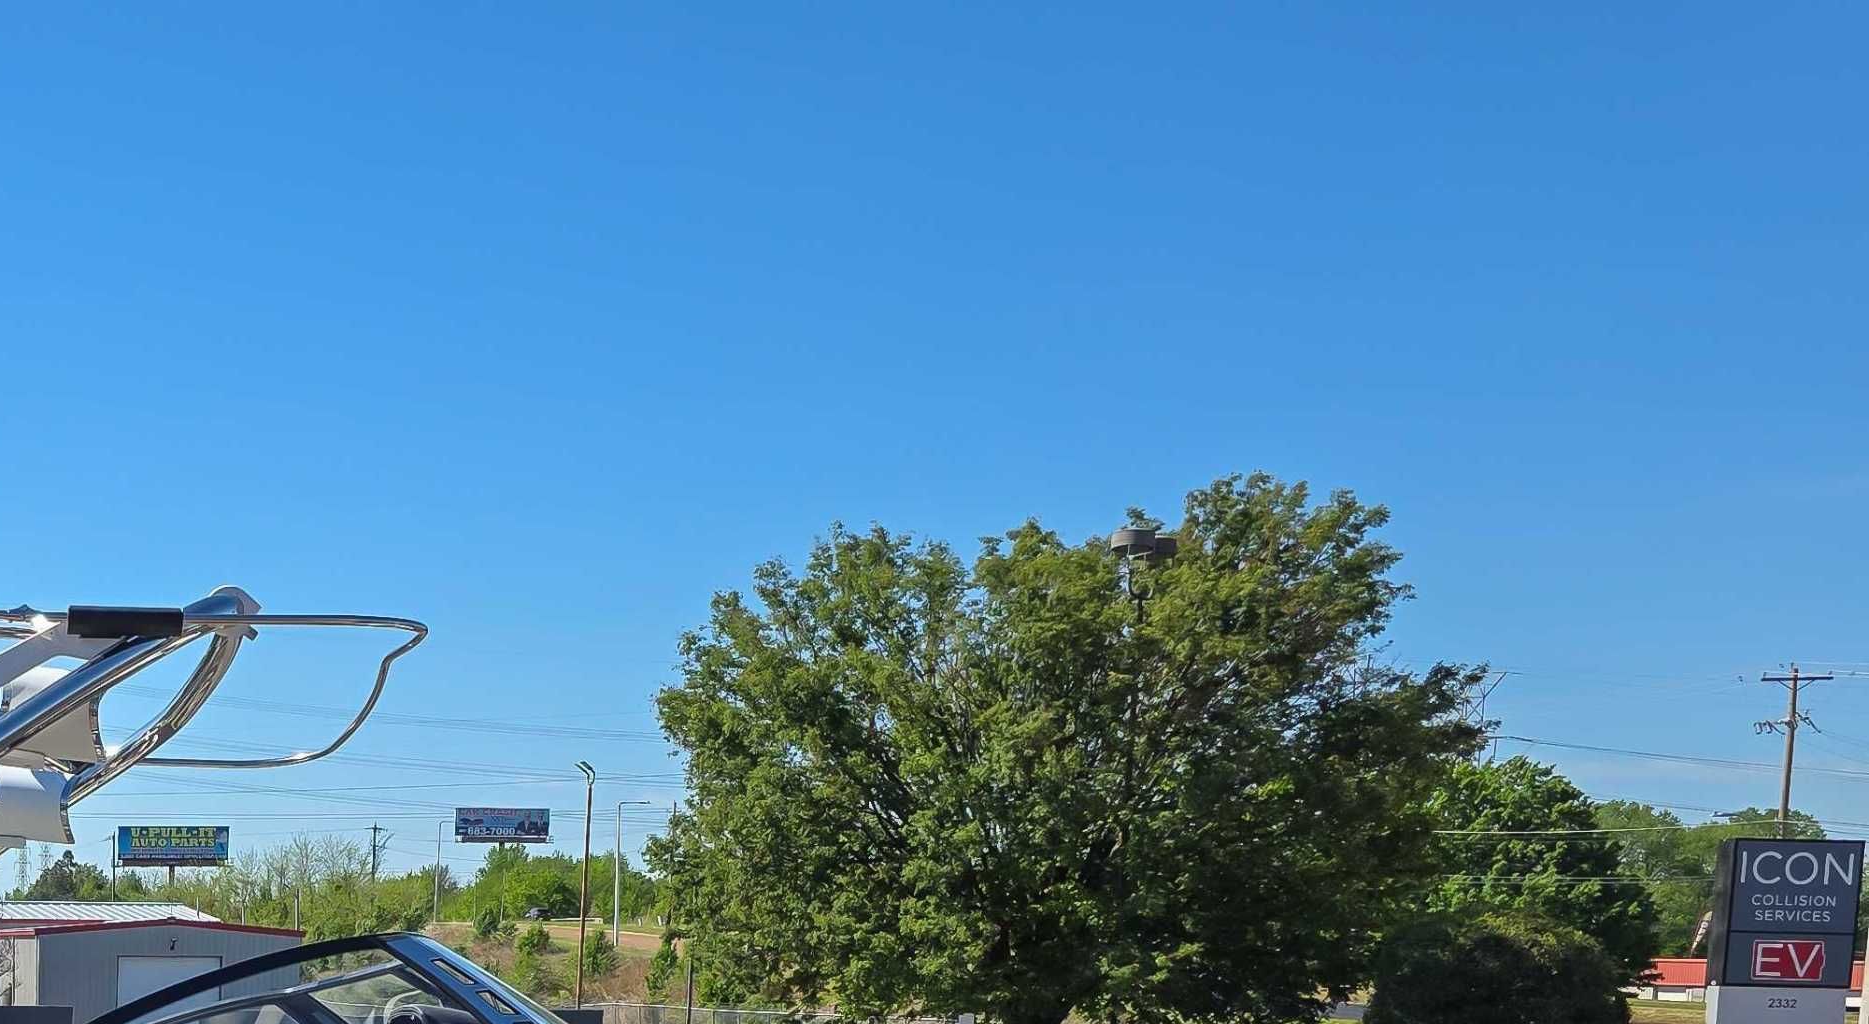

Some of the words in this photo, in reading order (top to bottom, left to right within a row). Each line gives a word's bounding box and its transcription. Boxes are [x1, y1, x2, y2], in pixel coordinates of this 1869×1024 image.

[131, 838, 168, 848] AUTO
[170, 838, 215, 847] PARTS
[1739, 850, 1855, 886] ICON
[1751, 893, 1837, 908] COLLISION
[1754, 909, 1832, 922] SERVICES
[1754, 943, 1822, 978] EV
[1767, 998, 1798, 1009] 2332
